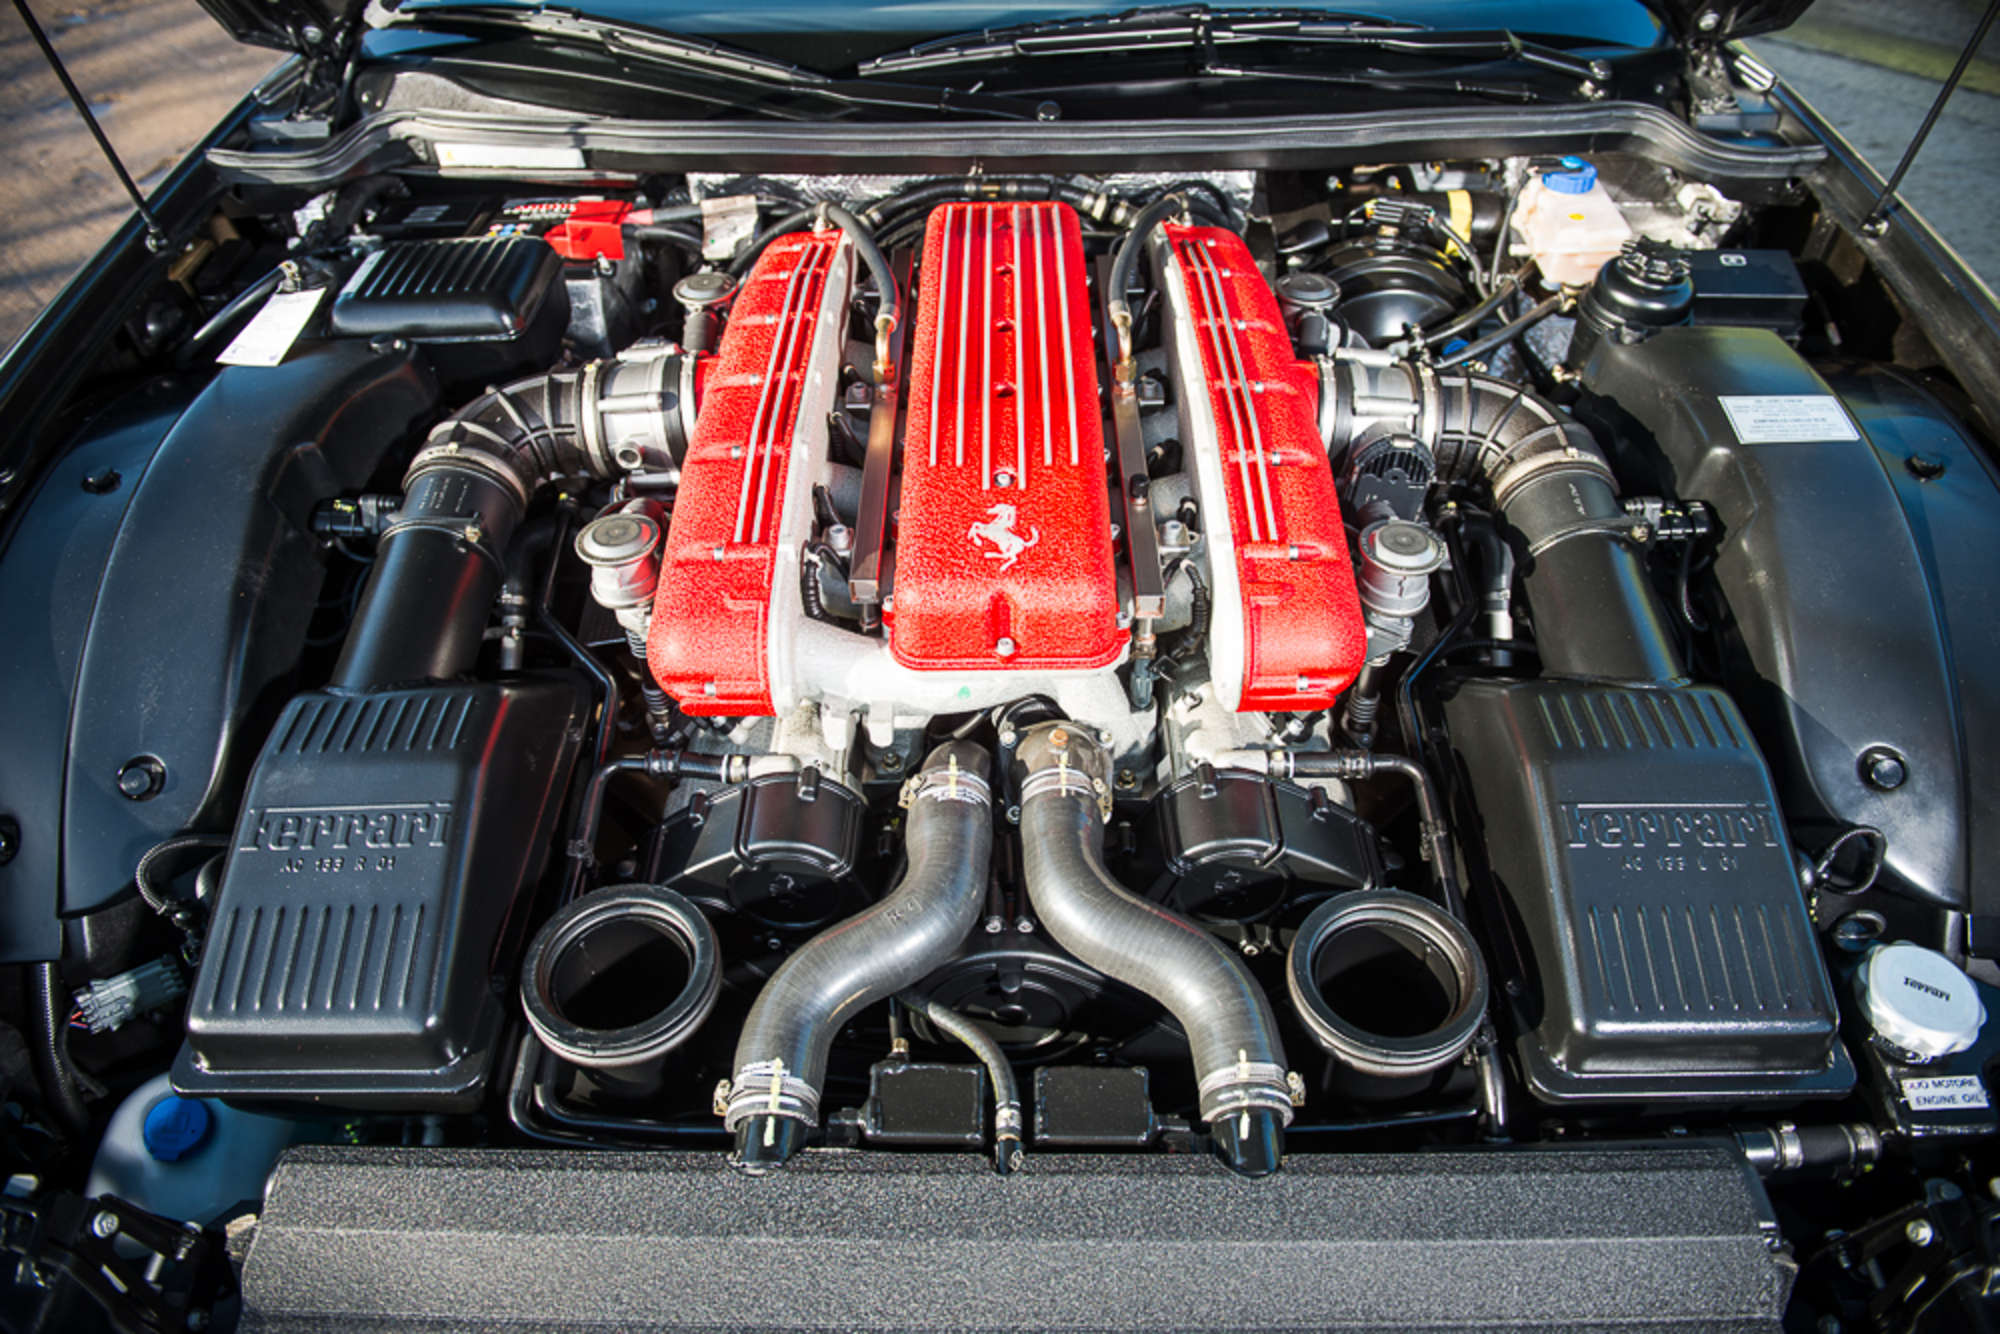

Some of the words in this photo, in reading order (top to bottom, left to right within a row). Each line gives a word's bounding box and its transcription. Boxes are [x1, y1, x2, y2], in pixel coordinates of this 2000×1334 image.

[240, 802, 451, 851] Ferrari
[1560, 801, 1779, 849] Ferrari
[1903, 976, 1951, 1002] Ferrari
[1931, 1077, 1977, 1089] MOTORE
[1916, 1094, 1958, 1105] ENGINE
[1961, 1092, 1983, 1104] OIL
